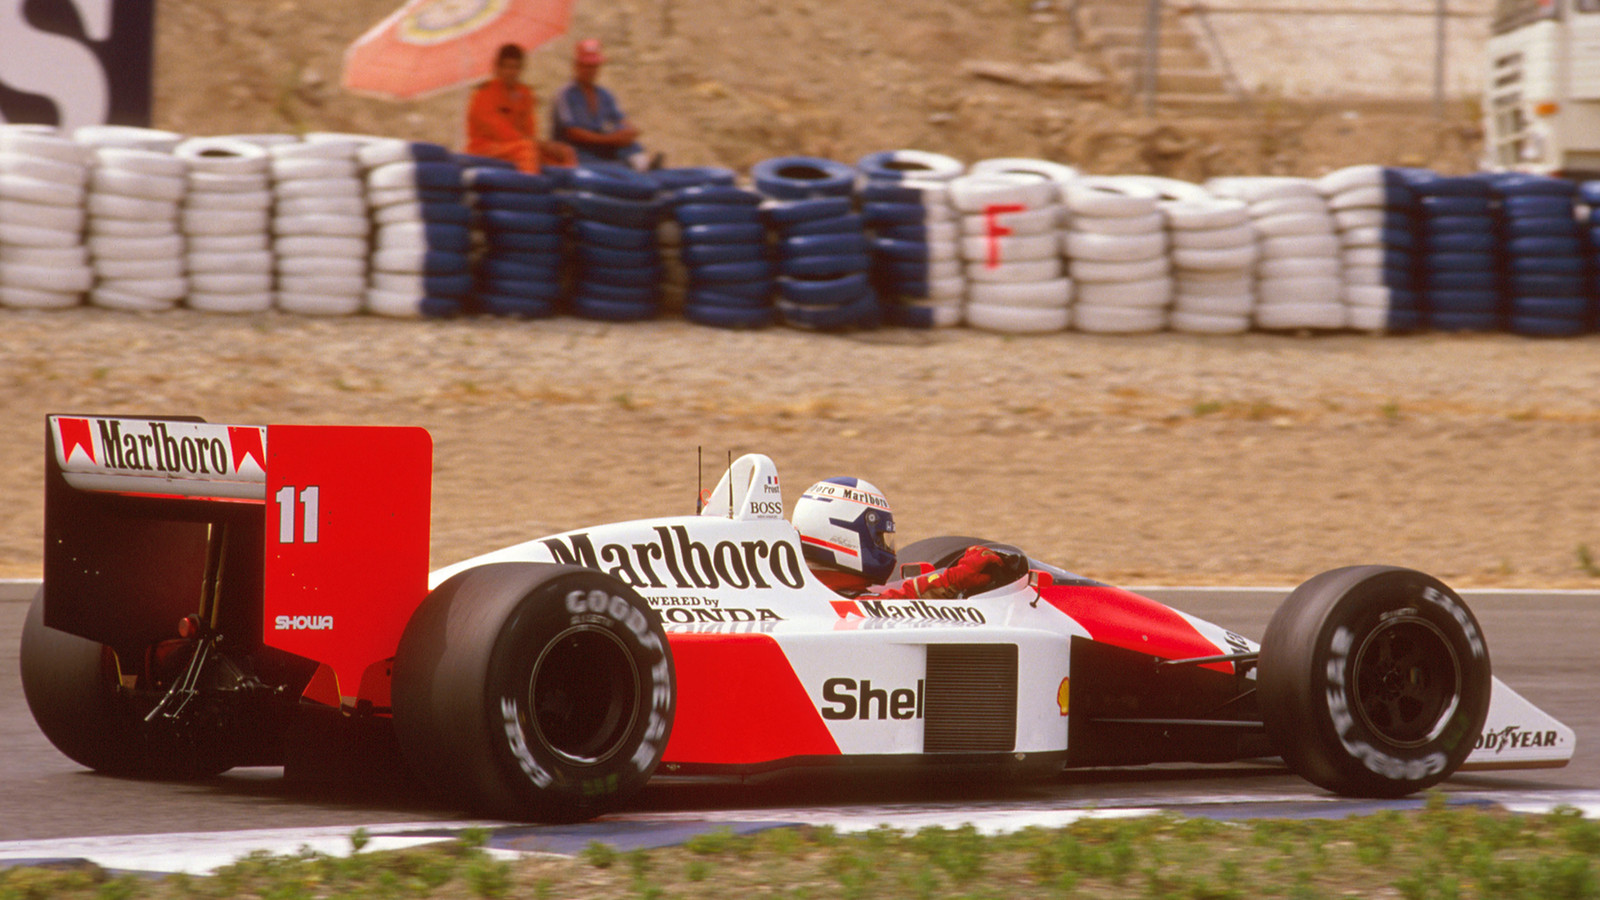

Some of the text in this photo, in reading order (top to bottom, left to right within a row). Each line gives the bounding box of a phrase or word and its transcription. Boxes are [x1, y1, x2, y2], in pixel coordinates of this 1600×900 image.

[984, 205, 1025, 270] F
[97, 419, 228, 475] Marlboro
[764, 484, 779, 493] Prost
[275, 485, 319, 544] 11
[750, 501, 782, 514] BOSS
[541, 525, 806, 590] Marlboro
[647, 596, 719, 607] WERED by
[859, 600, 986, 625] Marlboro
[275, 615, 334, 630] SHOWA
[821, 678, 924, 721] Shel
